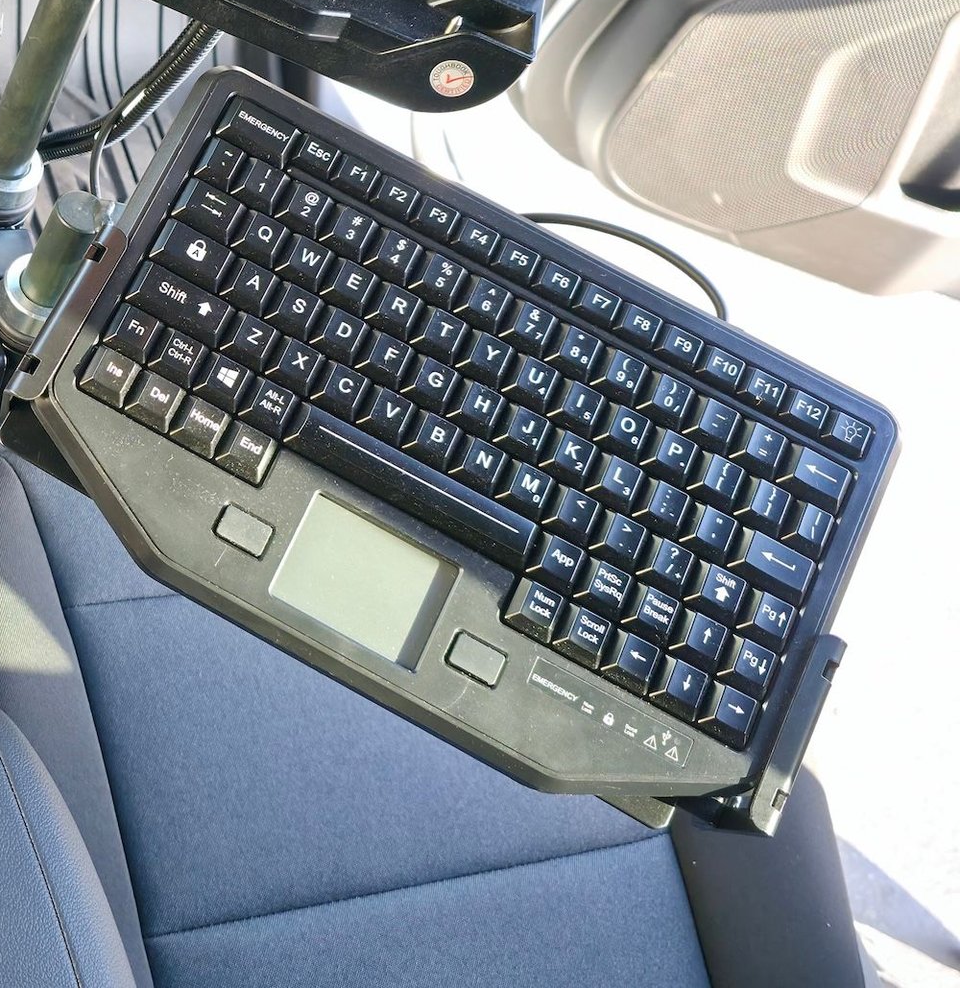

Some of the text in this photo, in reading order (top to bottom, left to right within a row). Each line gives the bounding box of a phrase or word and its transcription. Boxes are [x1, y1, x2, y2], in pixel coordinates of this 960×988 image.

[238, 110, 289, 143] EMERGENCY
[307, 143, 332, 161] Esc
[350, 165, 367, 182] F1
[258, 182, 265, 193] 1
[388, 187, 407, 203] F2
[300, 206, 310, 218] 2
[429, 208, 447, 224] F3
[258, 226, 273, 243] Q
[345, 228, 355, 240] 3
[470, 229, 487, 246] F4
[301, 248, 321, 267] W
[390, 252, 400, 266] 4
[510, 250, 528, 266] F5
[246, 274, 261, 290] A
[347, 274, 363, 289] E
[434, 276, 445, 289] 5
[551, 272, 570, 289] F6
[159, 281, 187, 304] Shift
[592, 293, 611, 309] F7
[293, 298, 306, 313] S
[392, 297, 407, 314] R
[481, 299, 491, 312] 6
[127, 319, 145, 336] Fn
[337, 322, 352, 338] D
[441, 322, 454, 337] T
[524, 323, 535, 333] 7
[633, 315, 651, 332] F8
[247, 327, 263, 344] Z
[173, 337, 194, 355] Ctrl-L
[570, 345, 580, 357] 8
[674, 336, 693, 353] F9
[168, 347, 192, 365] Ctrl-R
[291, 352, 310, 370] X
[384, 347, 400, 363] F
[486, 346, 500, 362] Y
[106, 361, 122, 377] Ins
[712, 356, 738, 377] F10
[428, 372, 444, 388] G
[529, 368, 544, 384] U
[615, 371, 625, 382] 9
[338, 378, 354, 393] C
[753, 378, 779, 398] F11
[150, 386, 170, 403] Del
[265, 389, 284, 404] Alt-L
[576, 395, 585, 408] I
[663, 397, 673, 408] 0
[259, 399, 282, 415] Alt-R
[386, 402, 401, 418] V
[474, 396, 491, 412] H
[796, 400, 822, 420] F12
[190, 409, 219, 431] Home
[584, 411, 591, 420] 5
[521, 420, 535, 433] J
[621, 417, 636, 433] O
[430, 426, 445, 443] B
[631, 436, 638, 445] 6
[240, 436, 261, 455] End
[565, 443, 584, 460] K
[668, 443, 682, 456] P
[476, 451, 492, 468] N
[520, 473, 540, 493] M
[613, 467, 624, 484] L
[623, 487, 630, 495] 3
[551, 548, 575, 568] App
[597, 568, 622, 588] PrtSc
[716, 572, 737, 589] Shift
[533, 589, 556, 608] Num
[593, 579, 622, 601] SysRq
[528, 600, 551, 619] Lock
[646, 593, 674, 614] Pause
[762, 603, 777, 621] Pg
[643, 604, 669, 626] Break
[580, 615, 605, 636] Scroll
[577, 626, 599, 645] Lock
[743, 650, 759, 668] Pg
[532, 673, 578, 702] EMERGENCY
